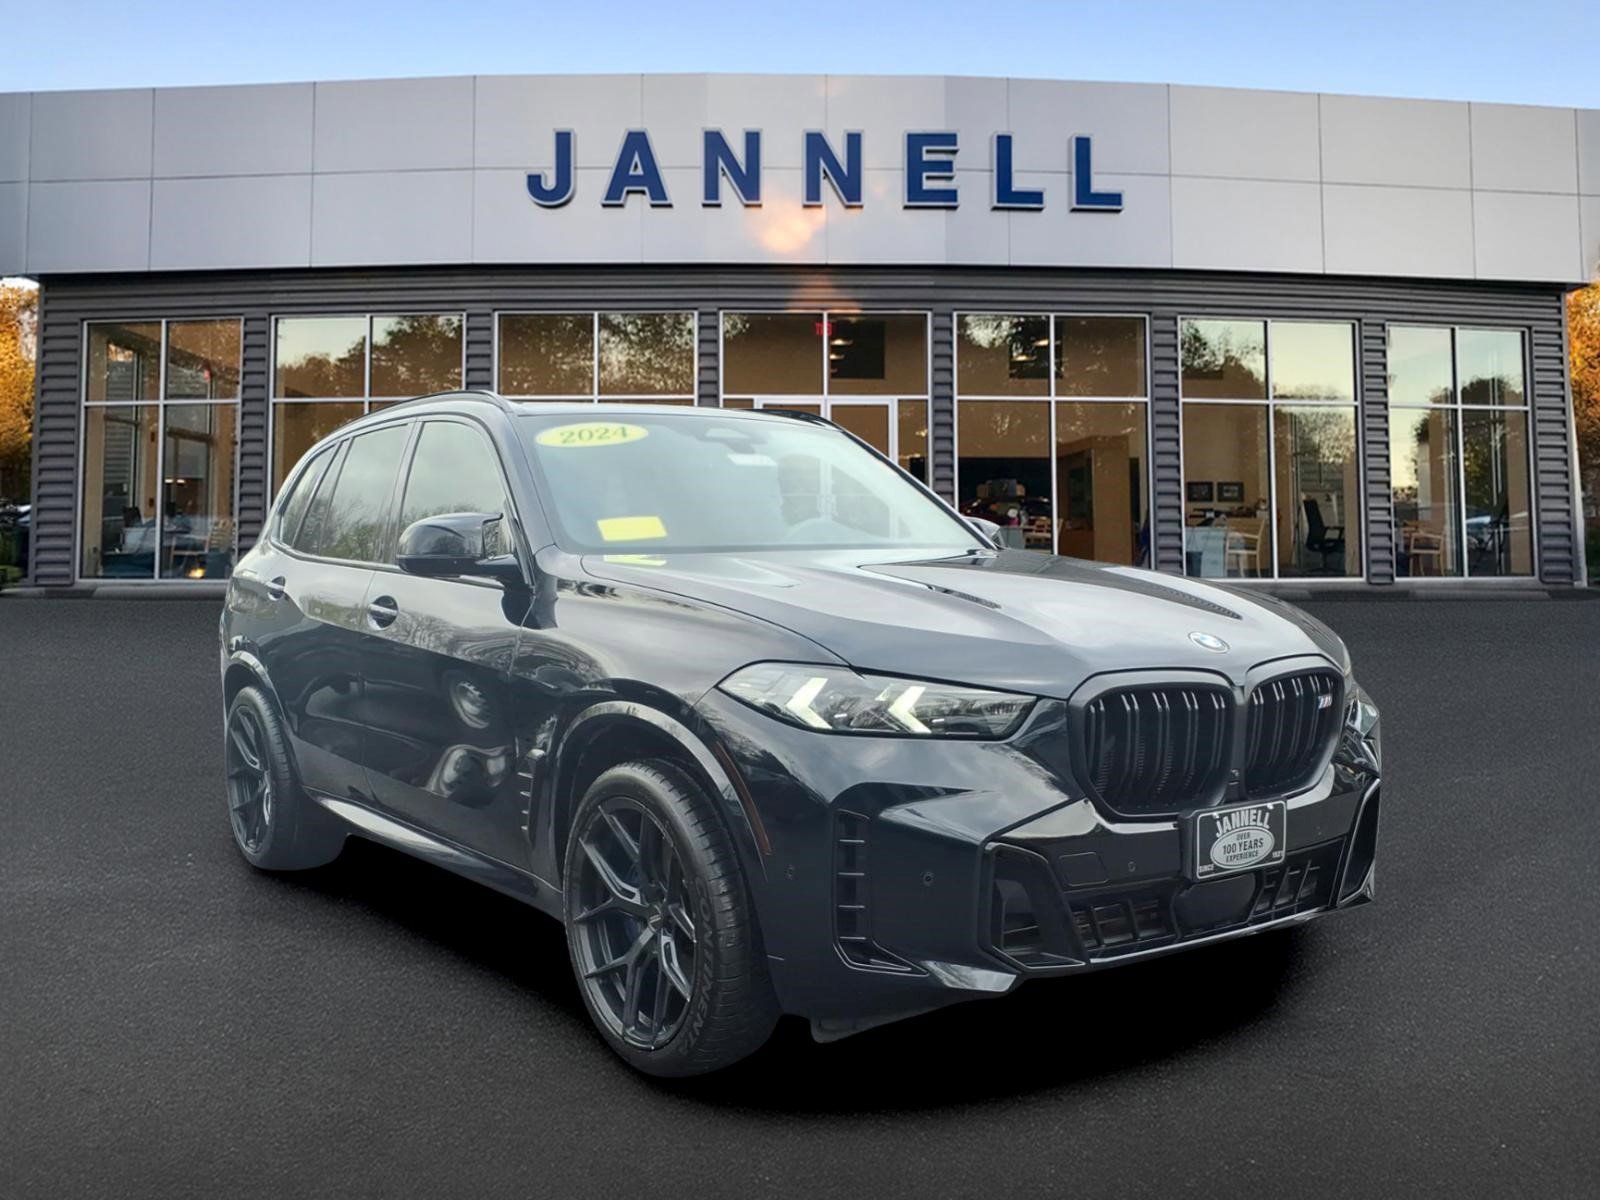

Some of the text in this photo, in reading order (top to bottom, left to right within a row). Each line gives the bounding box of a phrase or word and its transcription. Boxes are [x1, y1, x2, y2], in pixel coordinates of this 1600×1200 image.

[526, 128, 1123, 211] JANNELL
[560, 427, 627, 444] 2024
[1215, 809, 1270, 838] JANNELL
[1236, 832, 1250, 840] OVER
[1223, 837, 1264, 855] 100 YEARS
[1226, 850, 1258, 862] EXPERIENCE
